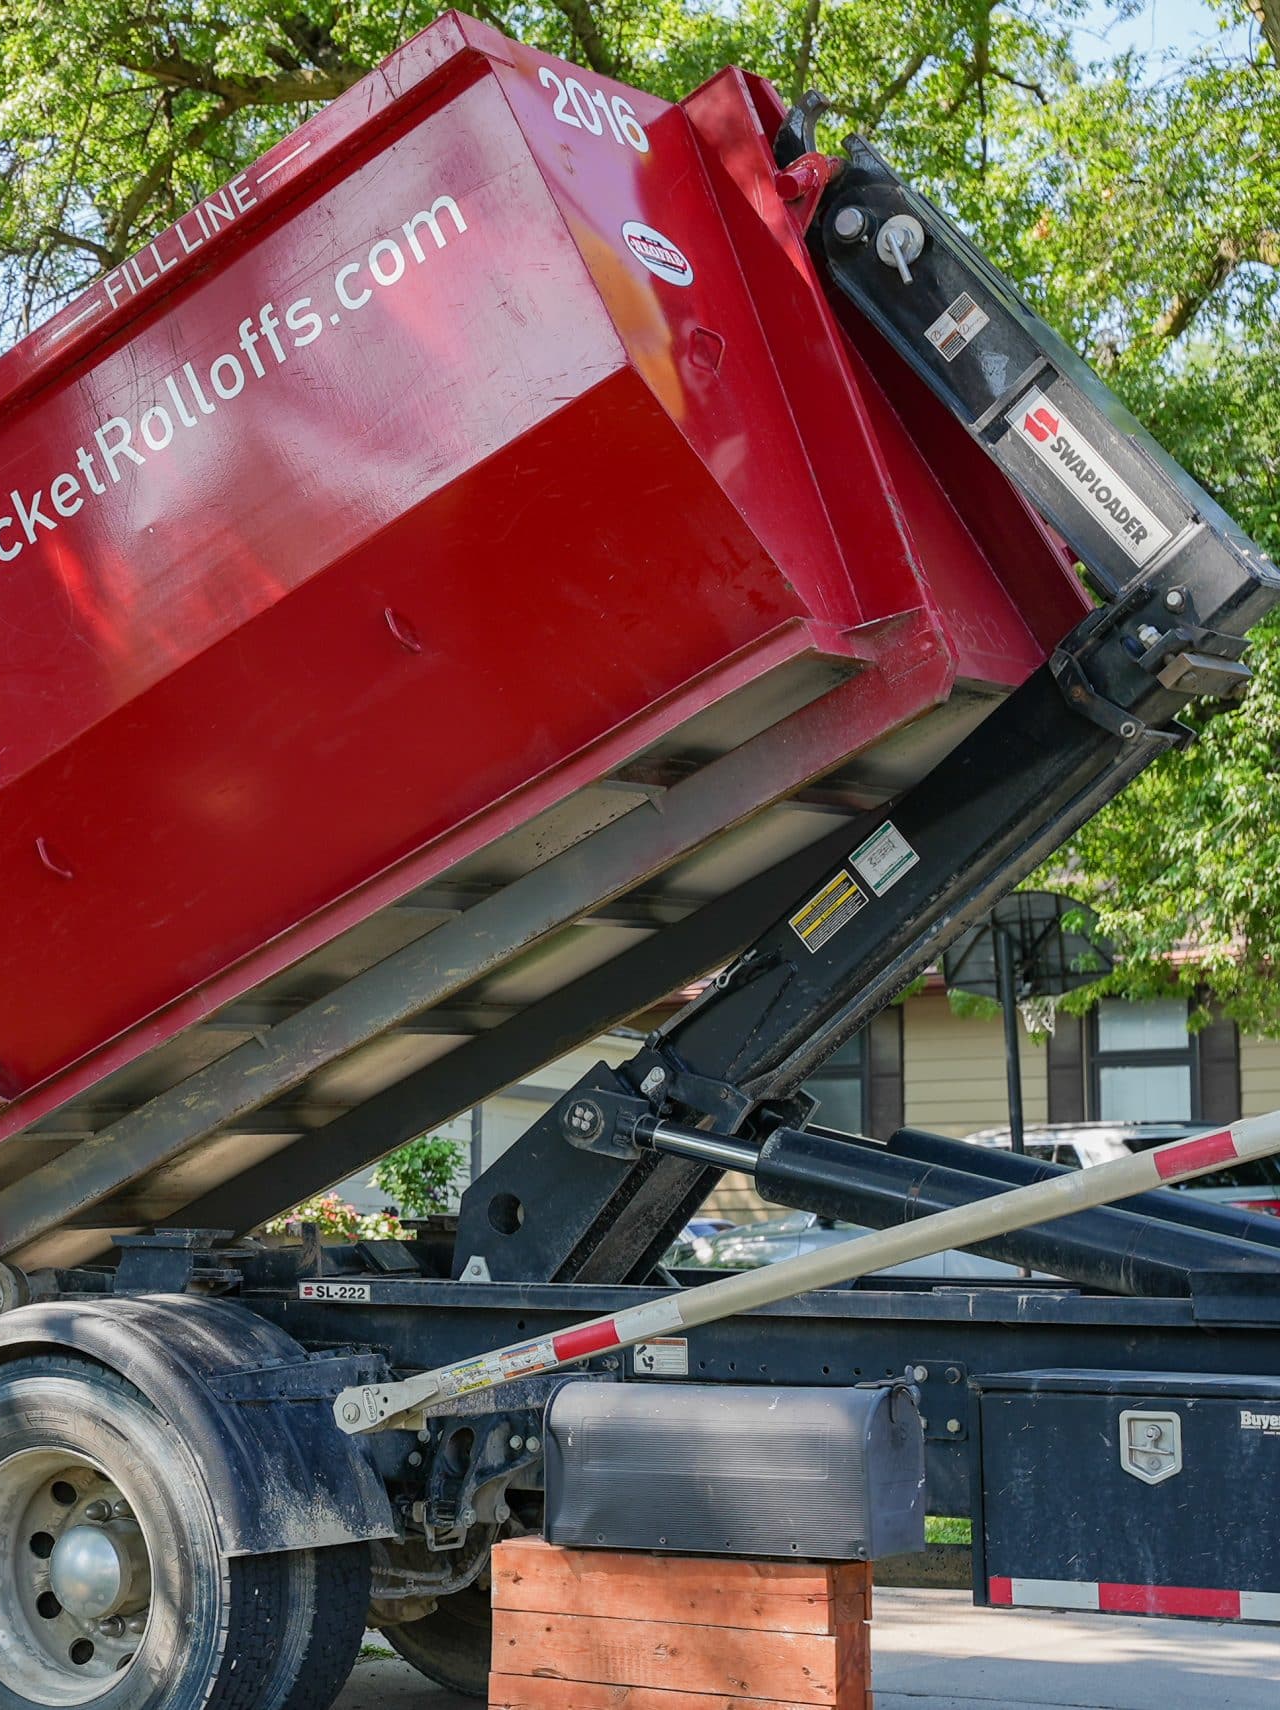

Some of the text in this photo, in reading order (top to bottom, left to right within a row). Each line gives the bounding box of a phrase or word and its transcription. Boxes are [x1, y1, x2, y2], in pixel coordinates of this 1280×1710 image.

[538, 66, 649, 153] 2016
[103, 173, 258, 310] FILL LINE
[1050, 436, 1149, 545] SWAPLOADER
[1240, 1410, 1280, 1429] Buye
